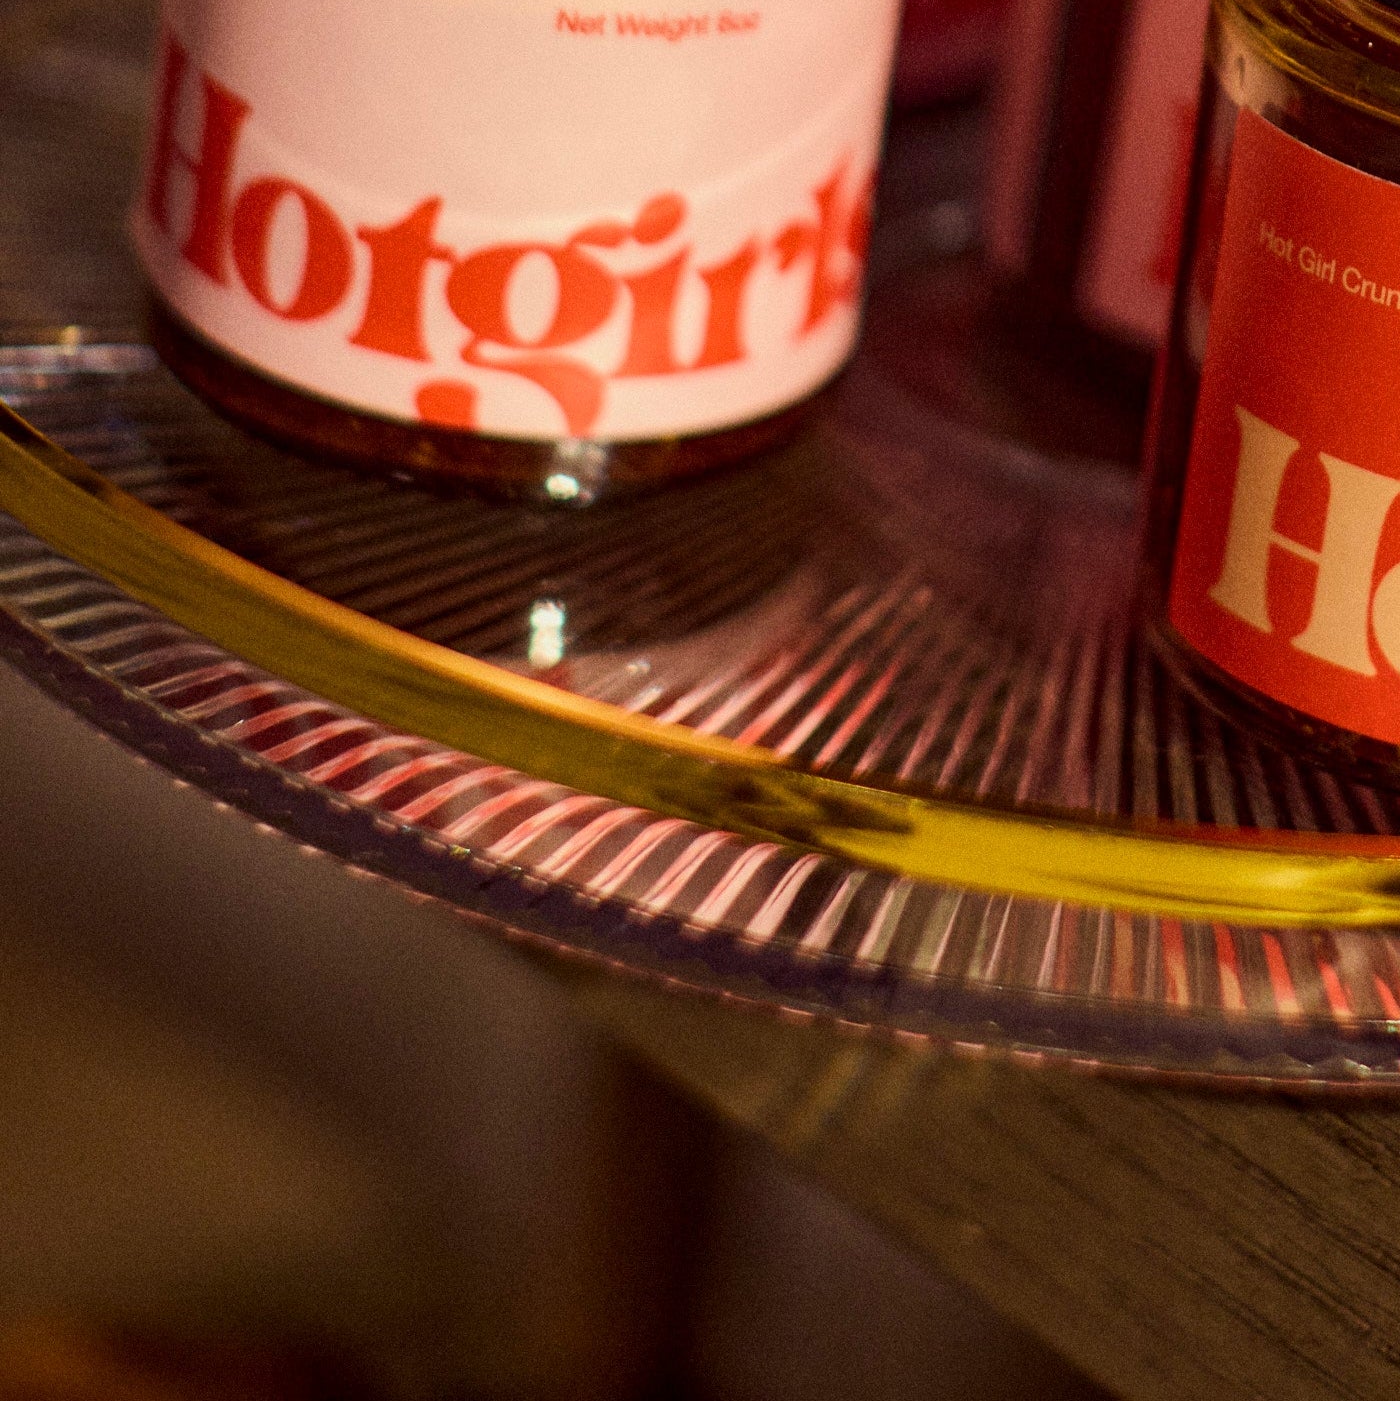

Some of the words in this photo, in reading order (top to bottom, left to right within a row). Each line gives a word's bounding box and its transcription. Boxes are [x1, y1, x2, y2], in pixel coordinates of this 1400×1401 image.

[555, 8, 606, 36] Net
[1258, 220, 1294, 263] Hot
[1298, 245, 1337, 285] Girl
